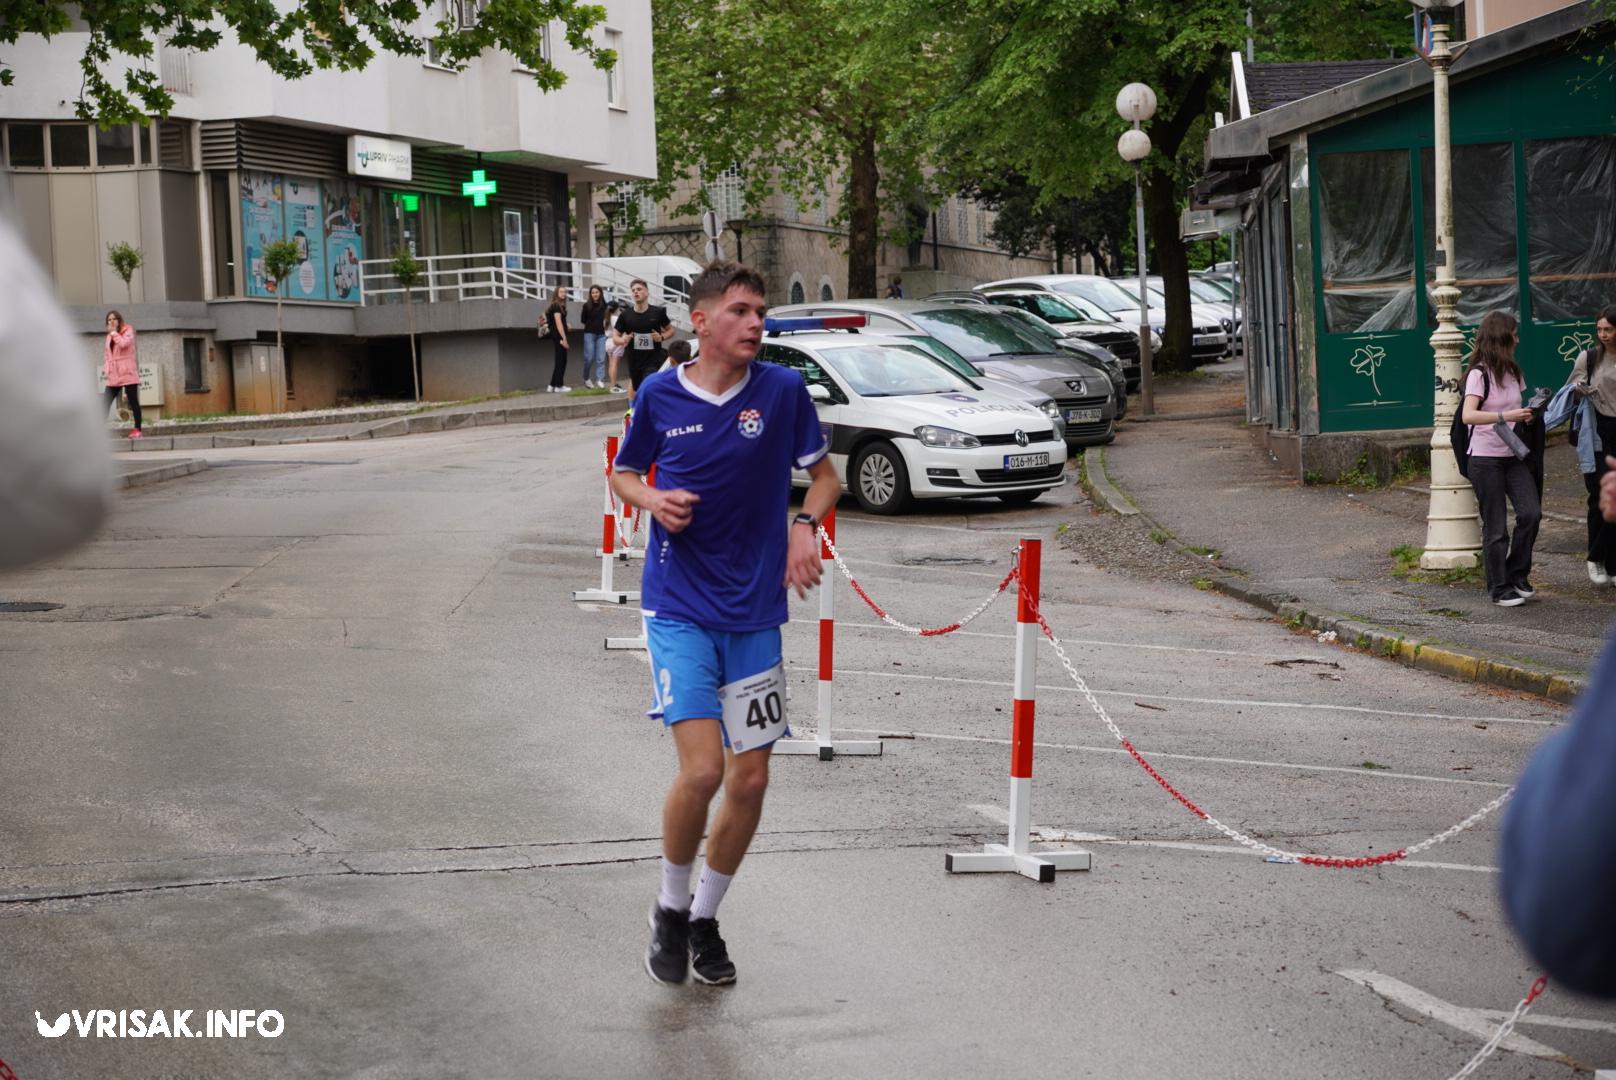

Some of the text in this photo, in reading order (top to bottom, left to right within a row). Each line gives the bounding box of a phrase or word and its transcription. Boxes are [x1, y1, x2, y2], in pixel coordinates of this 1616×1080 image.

[639, 338, 649, 347] 78
[946, 404, 1033, 418] POLICIJA
[665, 423, 704, 439] KELME
[659, 667, 674, 707] 2
[746, 690, 782, 730] 40
